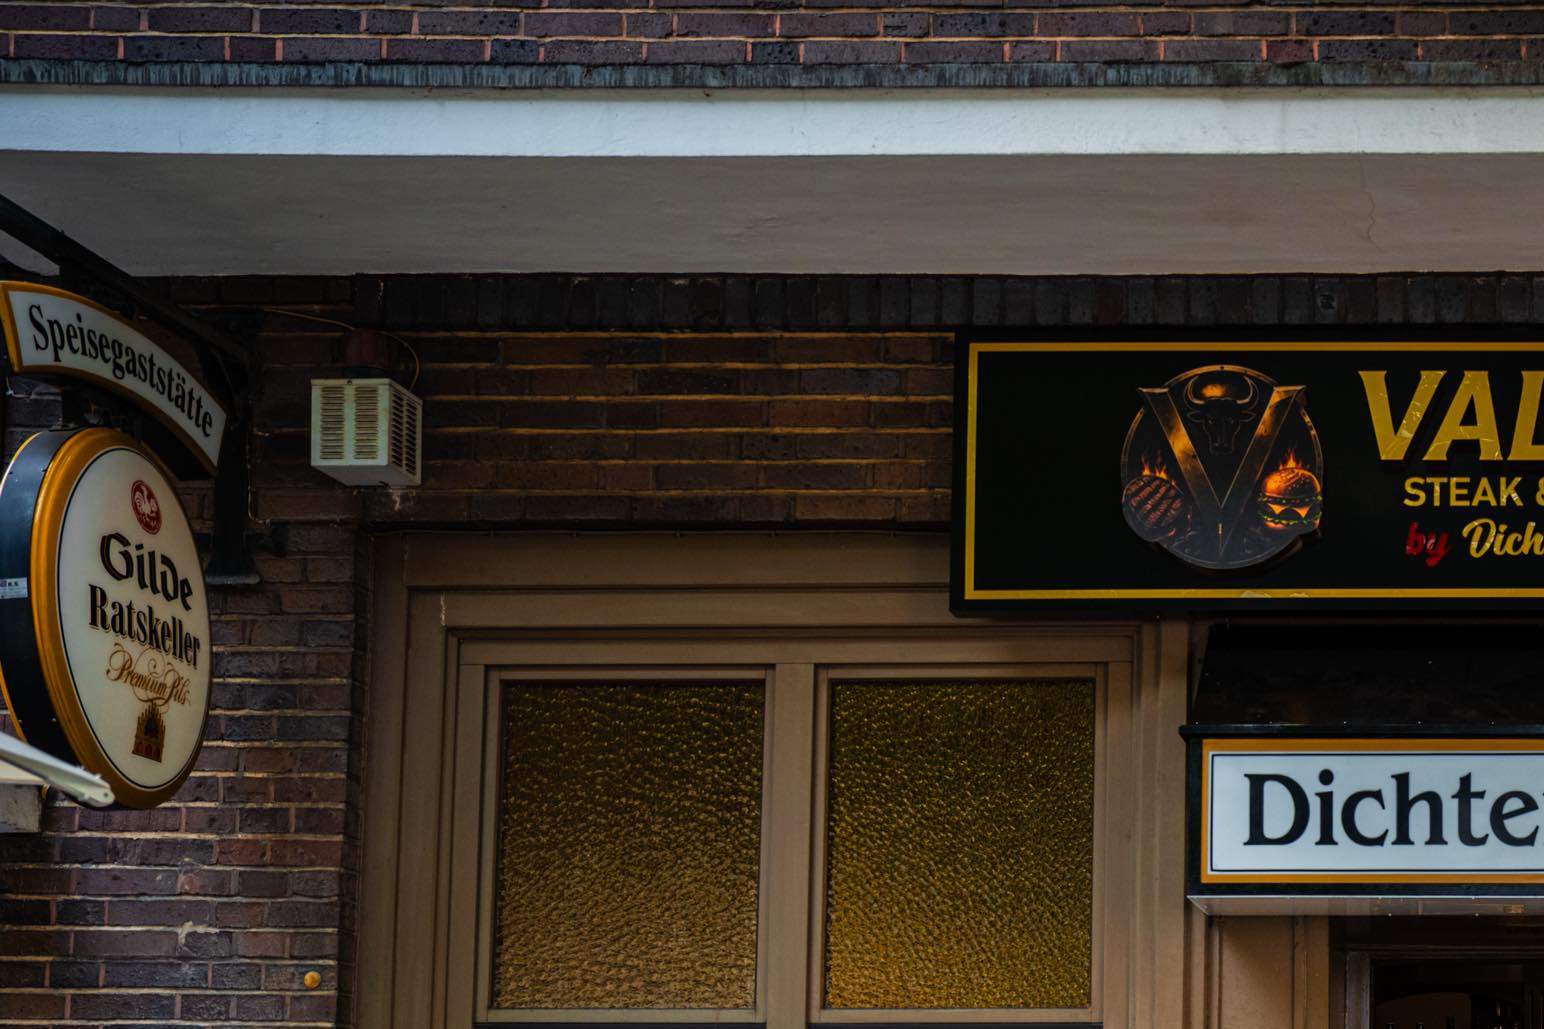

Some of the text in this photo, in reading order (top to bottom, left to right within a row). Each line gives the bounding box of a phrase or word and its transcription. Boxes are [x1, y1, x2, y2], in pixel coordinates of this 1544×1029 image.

[28, 304, 213, 438] Speisegaststätte
[1403, 476, 1524, 507] STEAK
[100, 532, 193, 612] Gilde
[1405, 521, 1450, 567] by
[88, 583, 200, 671] Ratskeller
[105, 643, 191, 706] Premium Pils
